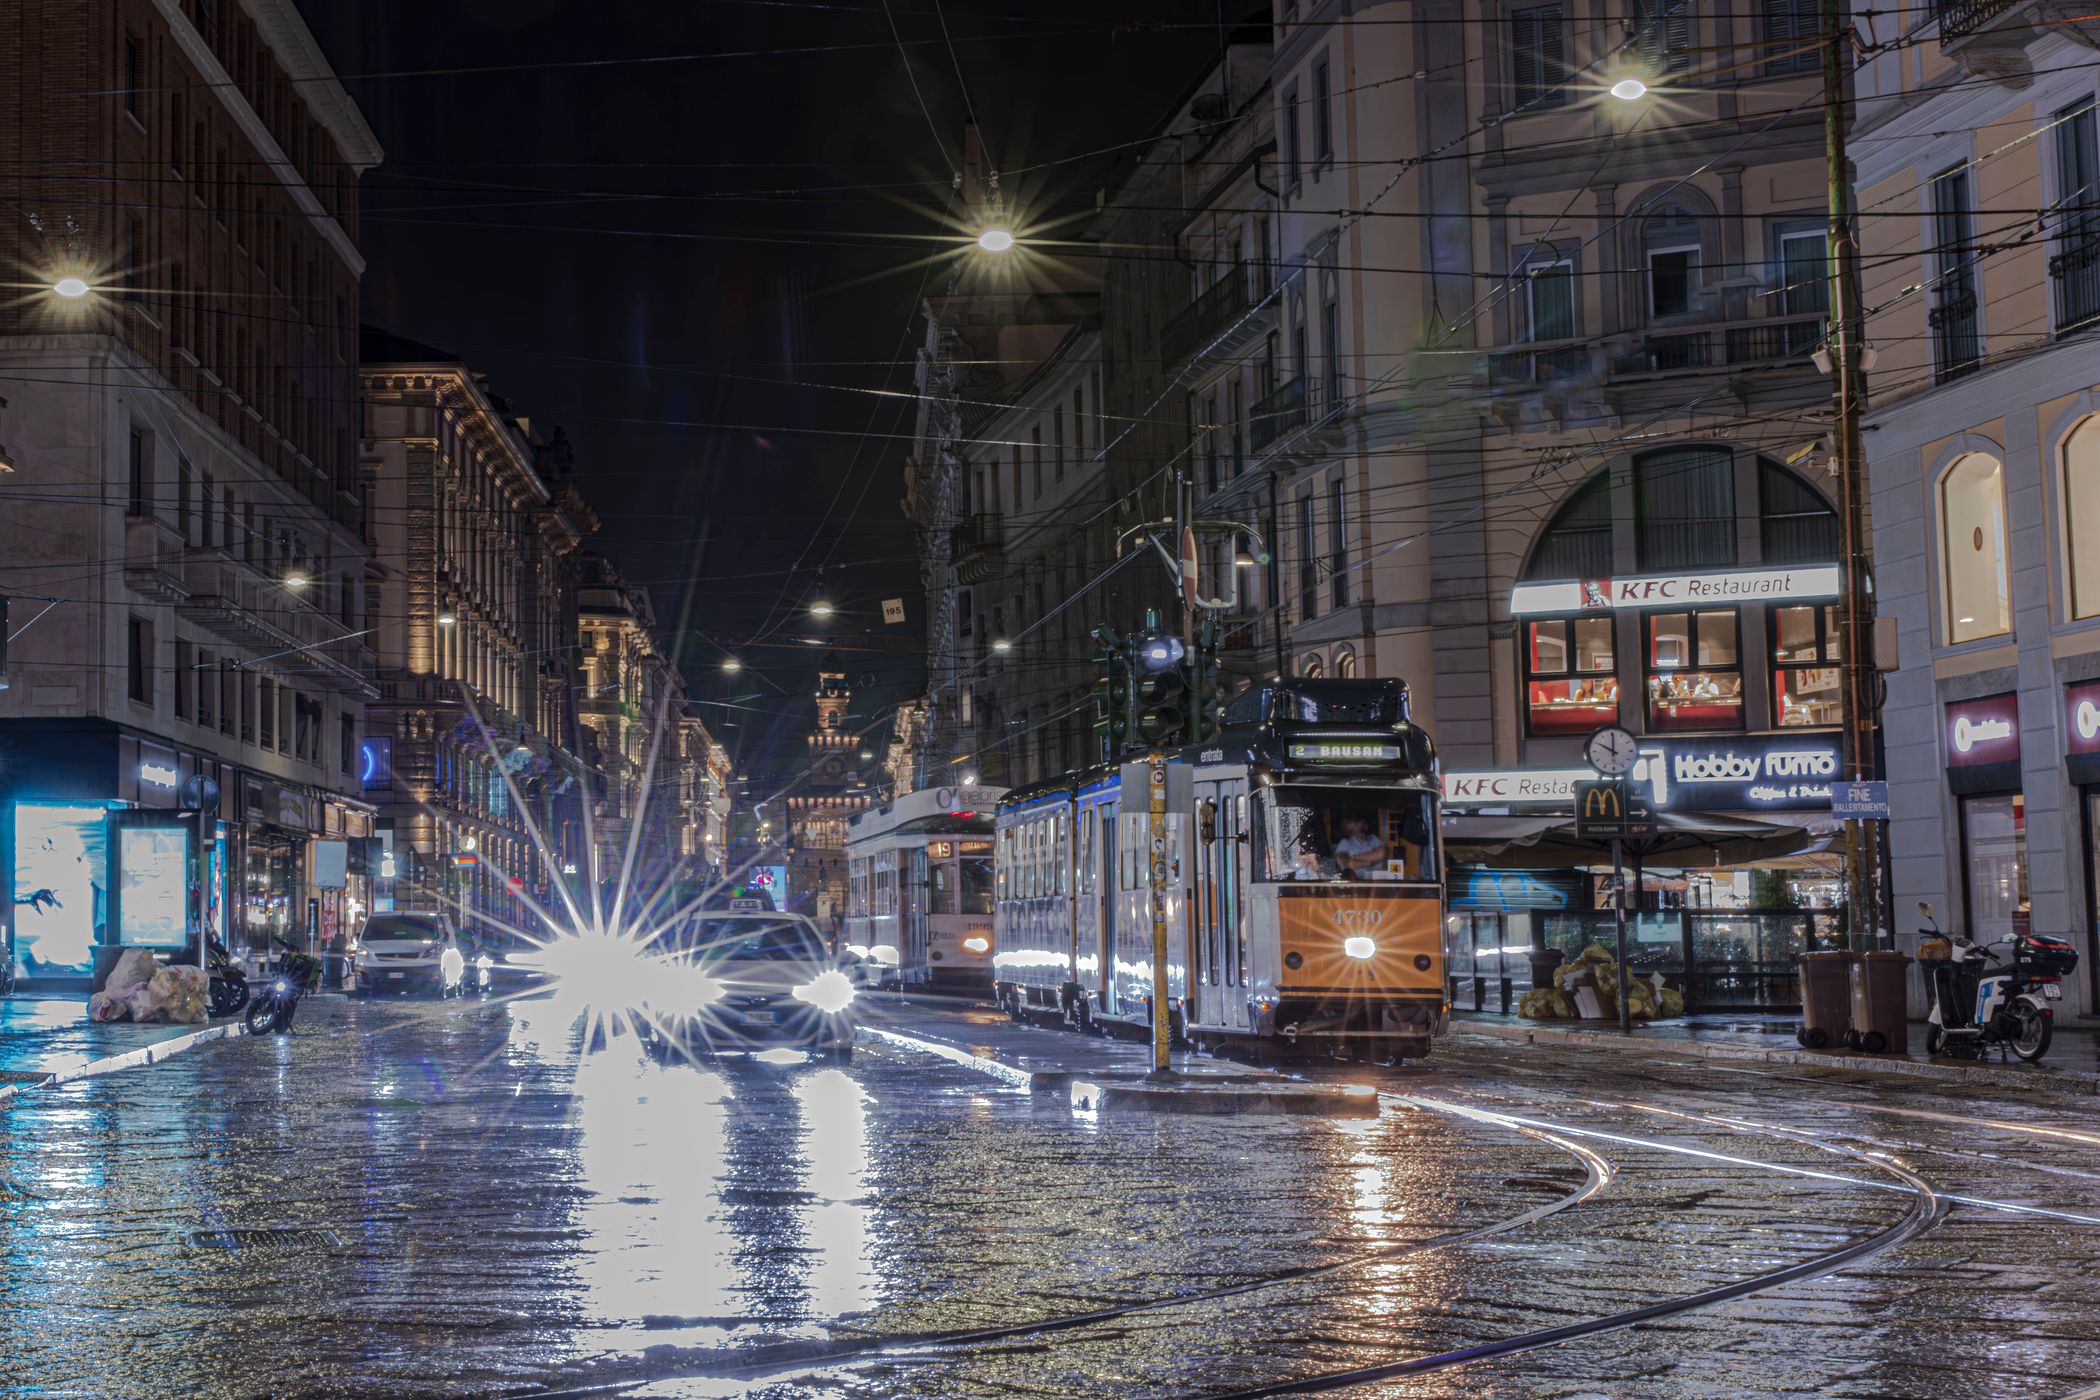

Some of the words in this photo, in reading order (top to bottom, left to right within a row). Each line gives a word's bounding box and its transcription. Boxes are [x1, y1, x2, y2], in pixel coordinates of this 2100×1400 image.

[1620, 580, 1678, 600] KFC
[1687, 574, 1792, 597] Restaurant
[886, 606, 901, 616] 195
[1200, 748, 1223, 763] entrata
[1295, 746, 1305, 756] 2
[1674, 752, 1762, 782] Hobby
[1453, 778, 1509, 796] KFC
[1847, 788, 1872, 802] FINE
[1833, 802, 1887, 812] RALLENTAMENTO
[937, 842, 951, 857] 19
